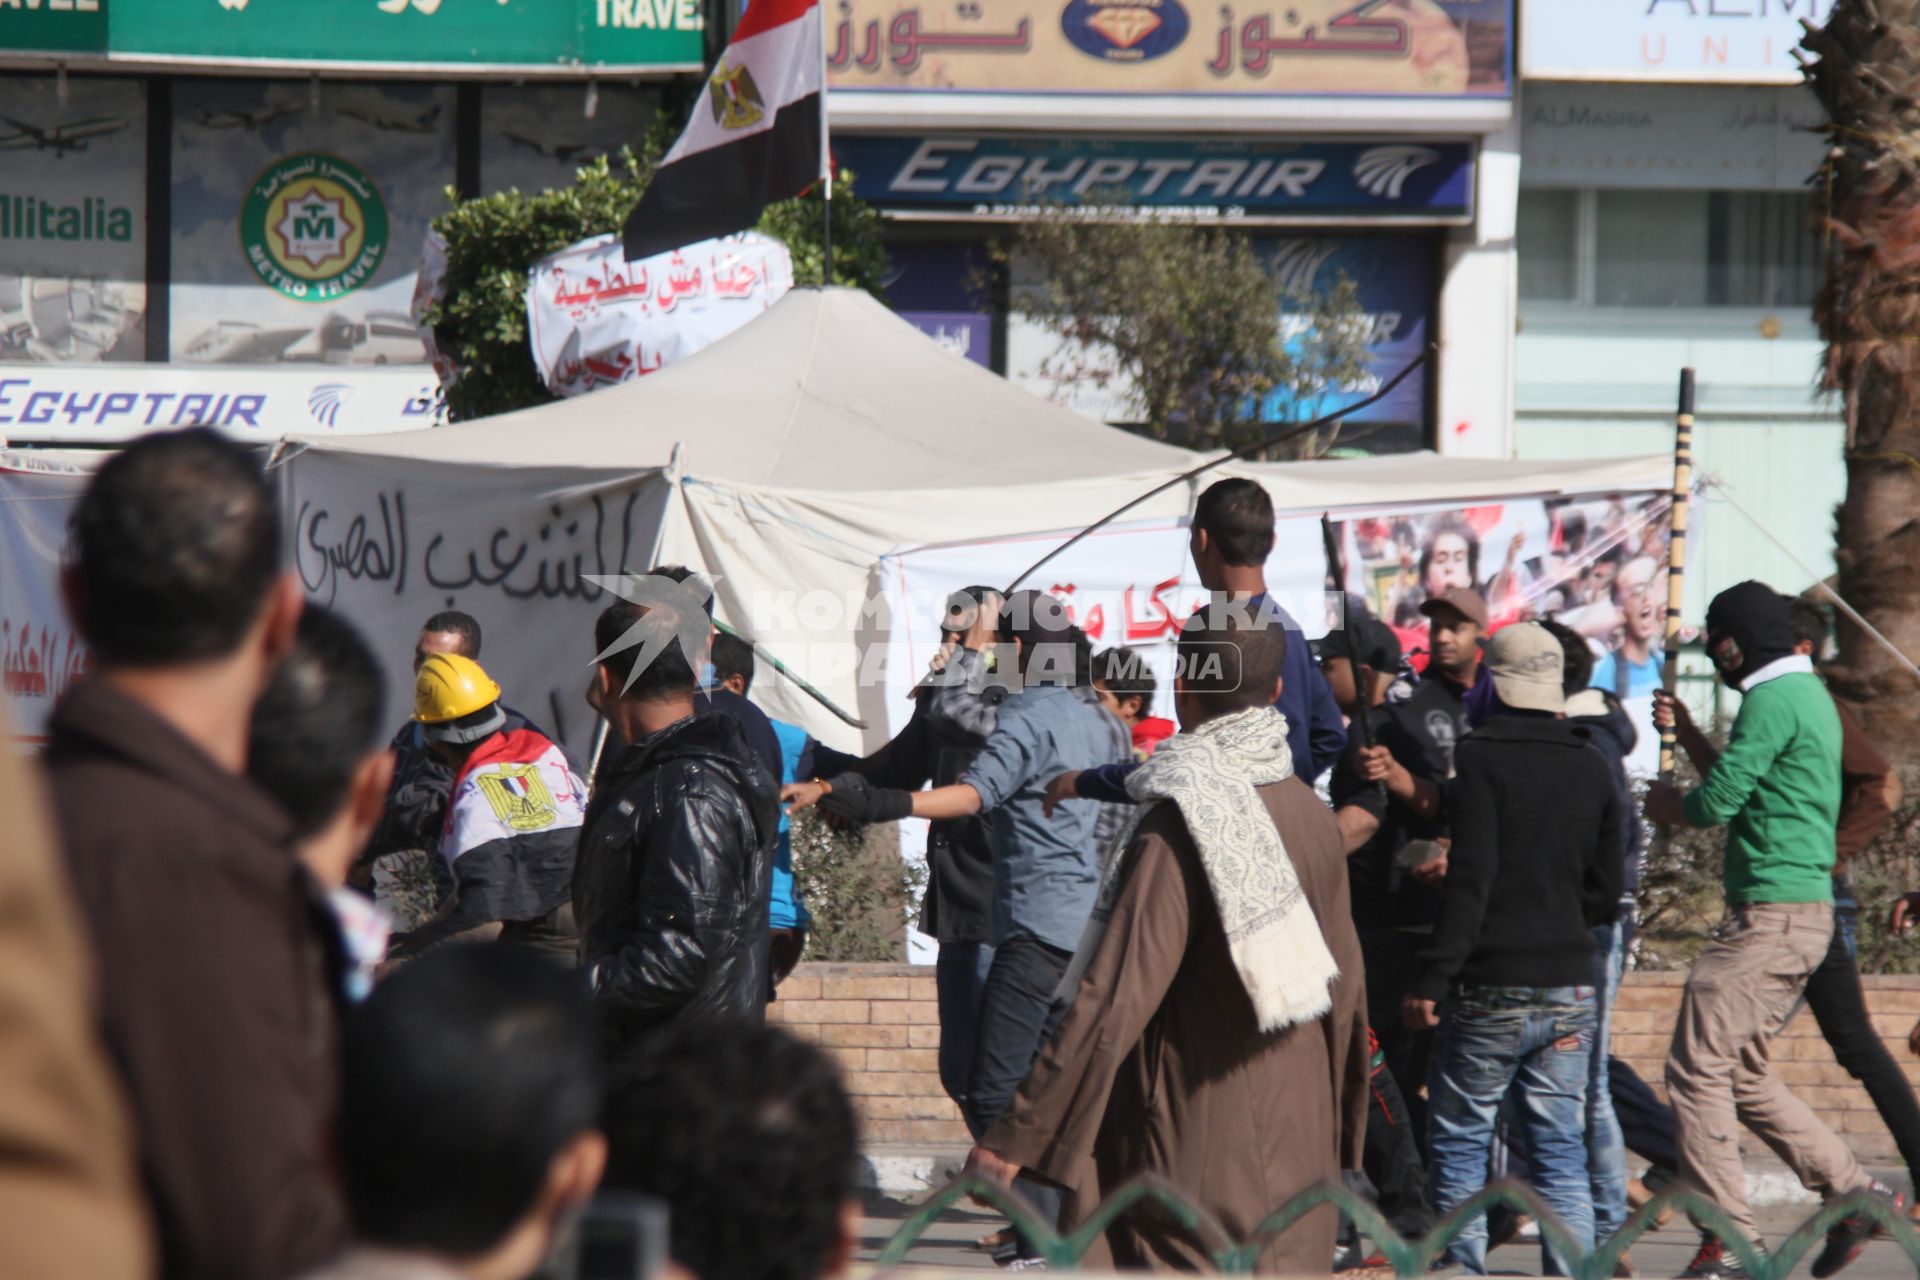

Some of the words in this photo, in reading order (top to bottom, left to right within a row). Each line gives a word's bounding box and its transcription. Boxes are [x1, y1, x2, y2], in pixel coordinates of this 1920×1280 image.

[827, 0, 1030, 67] تورز
[1208, 0, 1409, 72] كنوز
[249, 244, 309, 298] METRO
[316, 242, 381, 298] TRAVEL
[425, 490, 640, 608] الشعب
